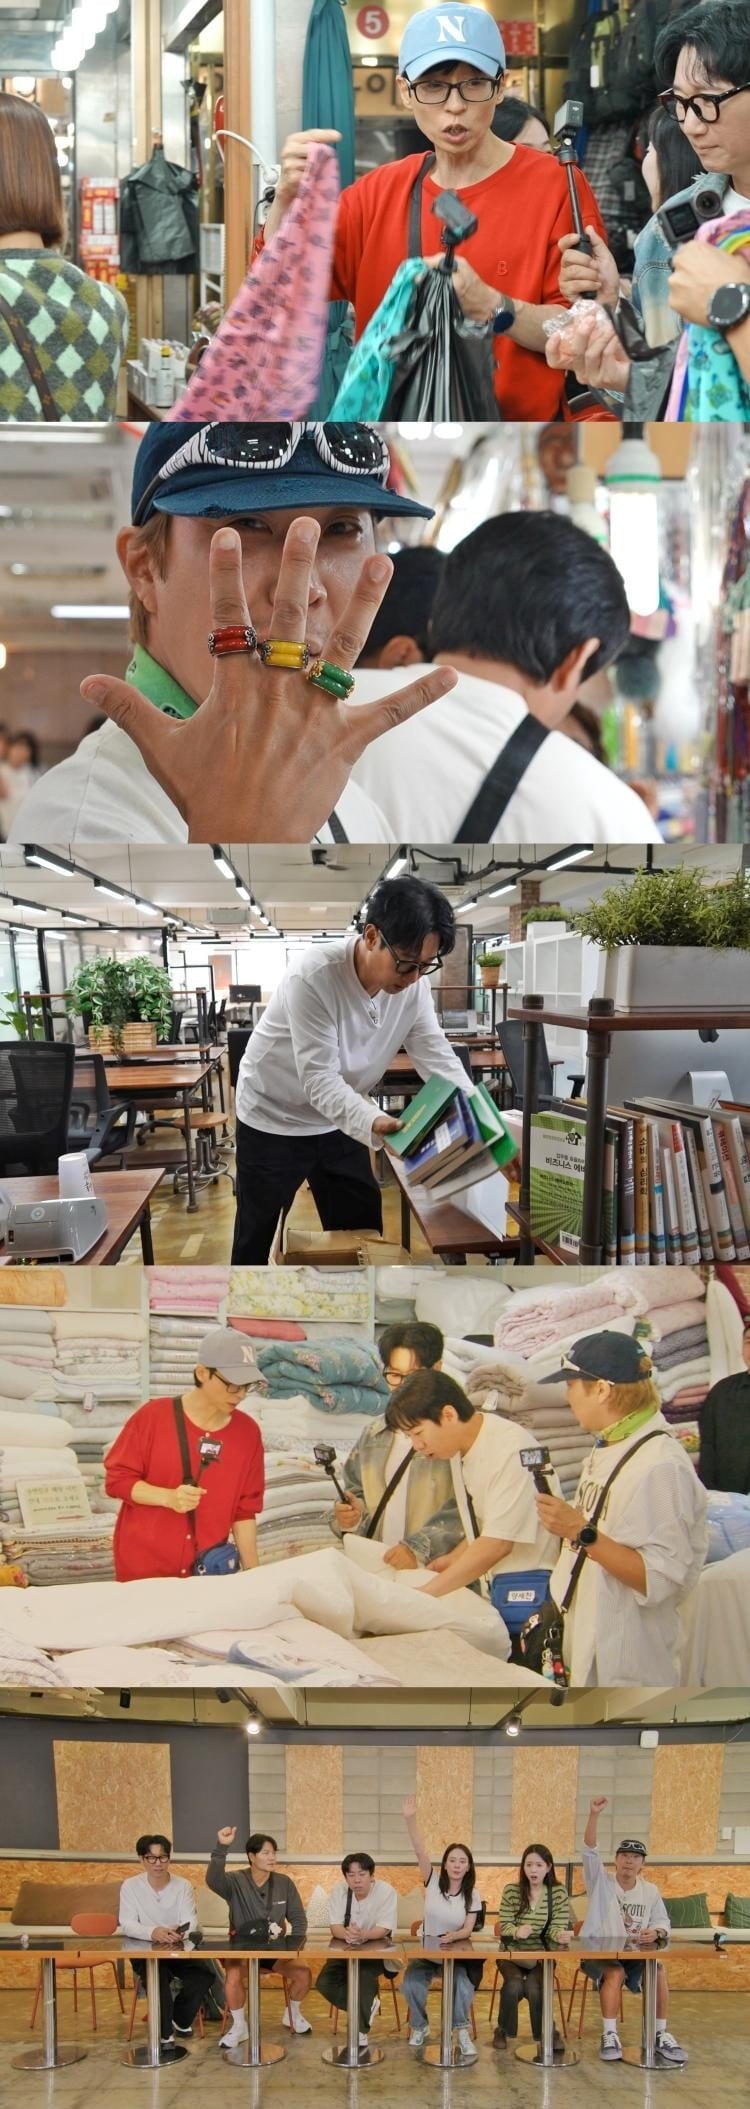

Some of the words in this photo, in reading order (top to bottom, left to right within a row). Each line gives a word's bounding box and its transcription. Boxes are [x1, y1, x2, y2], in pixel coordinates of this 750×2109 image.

[364, 11, 382, 34] 5
[435, 15, 466, 43] N
[545, 1156, 572, 1170] 비즈니스
[240, 1344, 255, 1363] N
